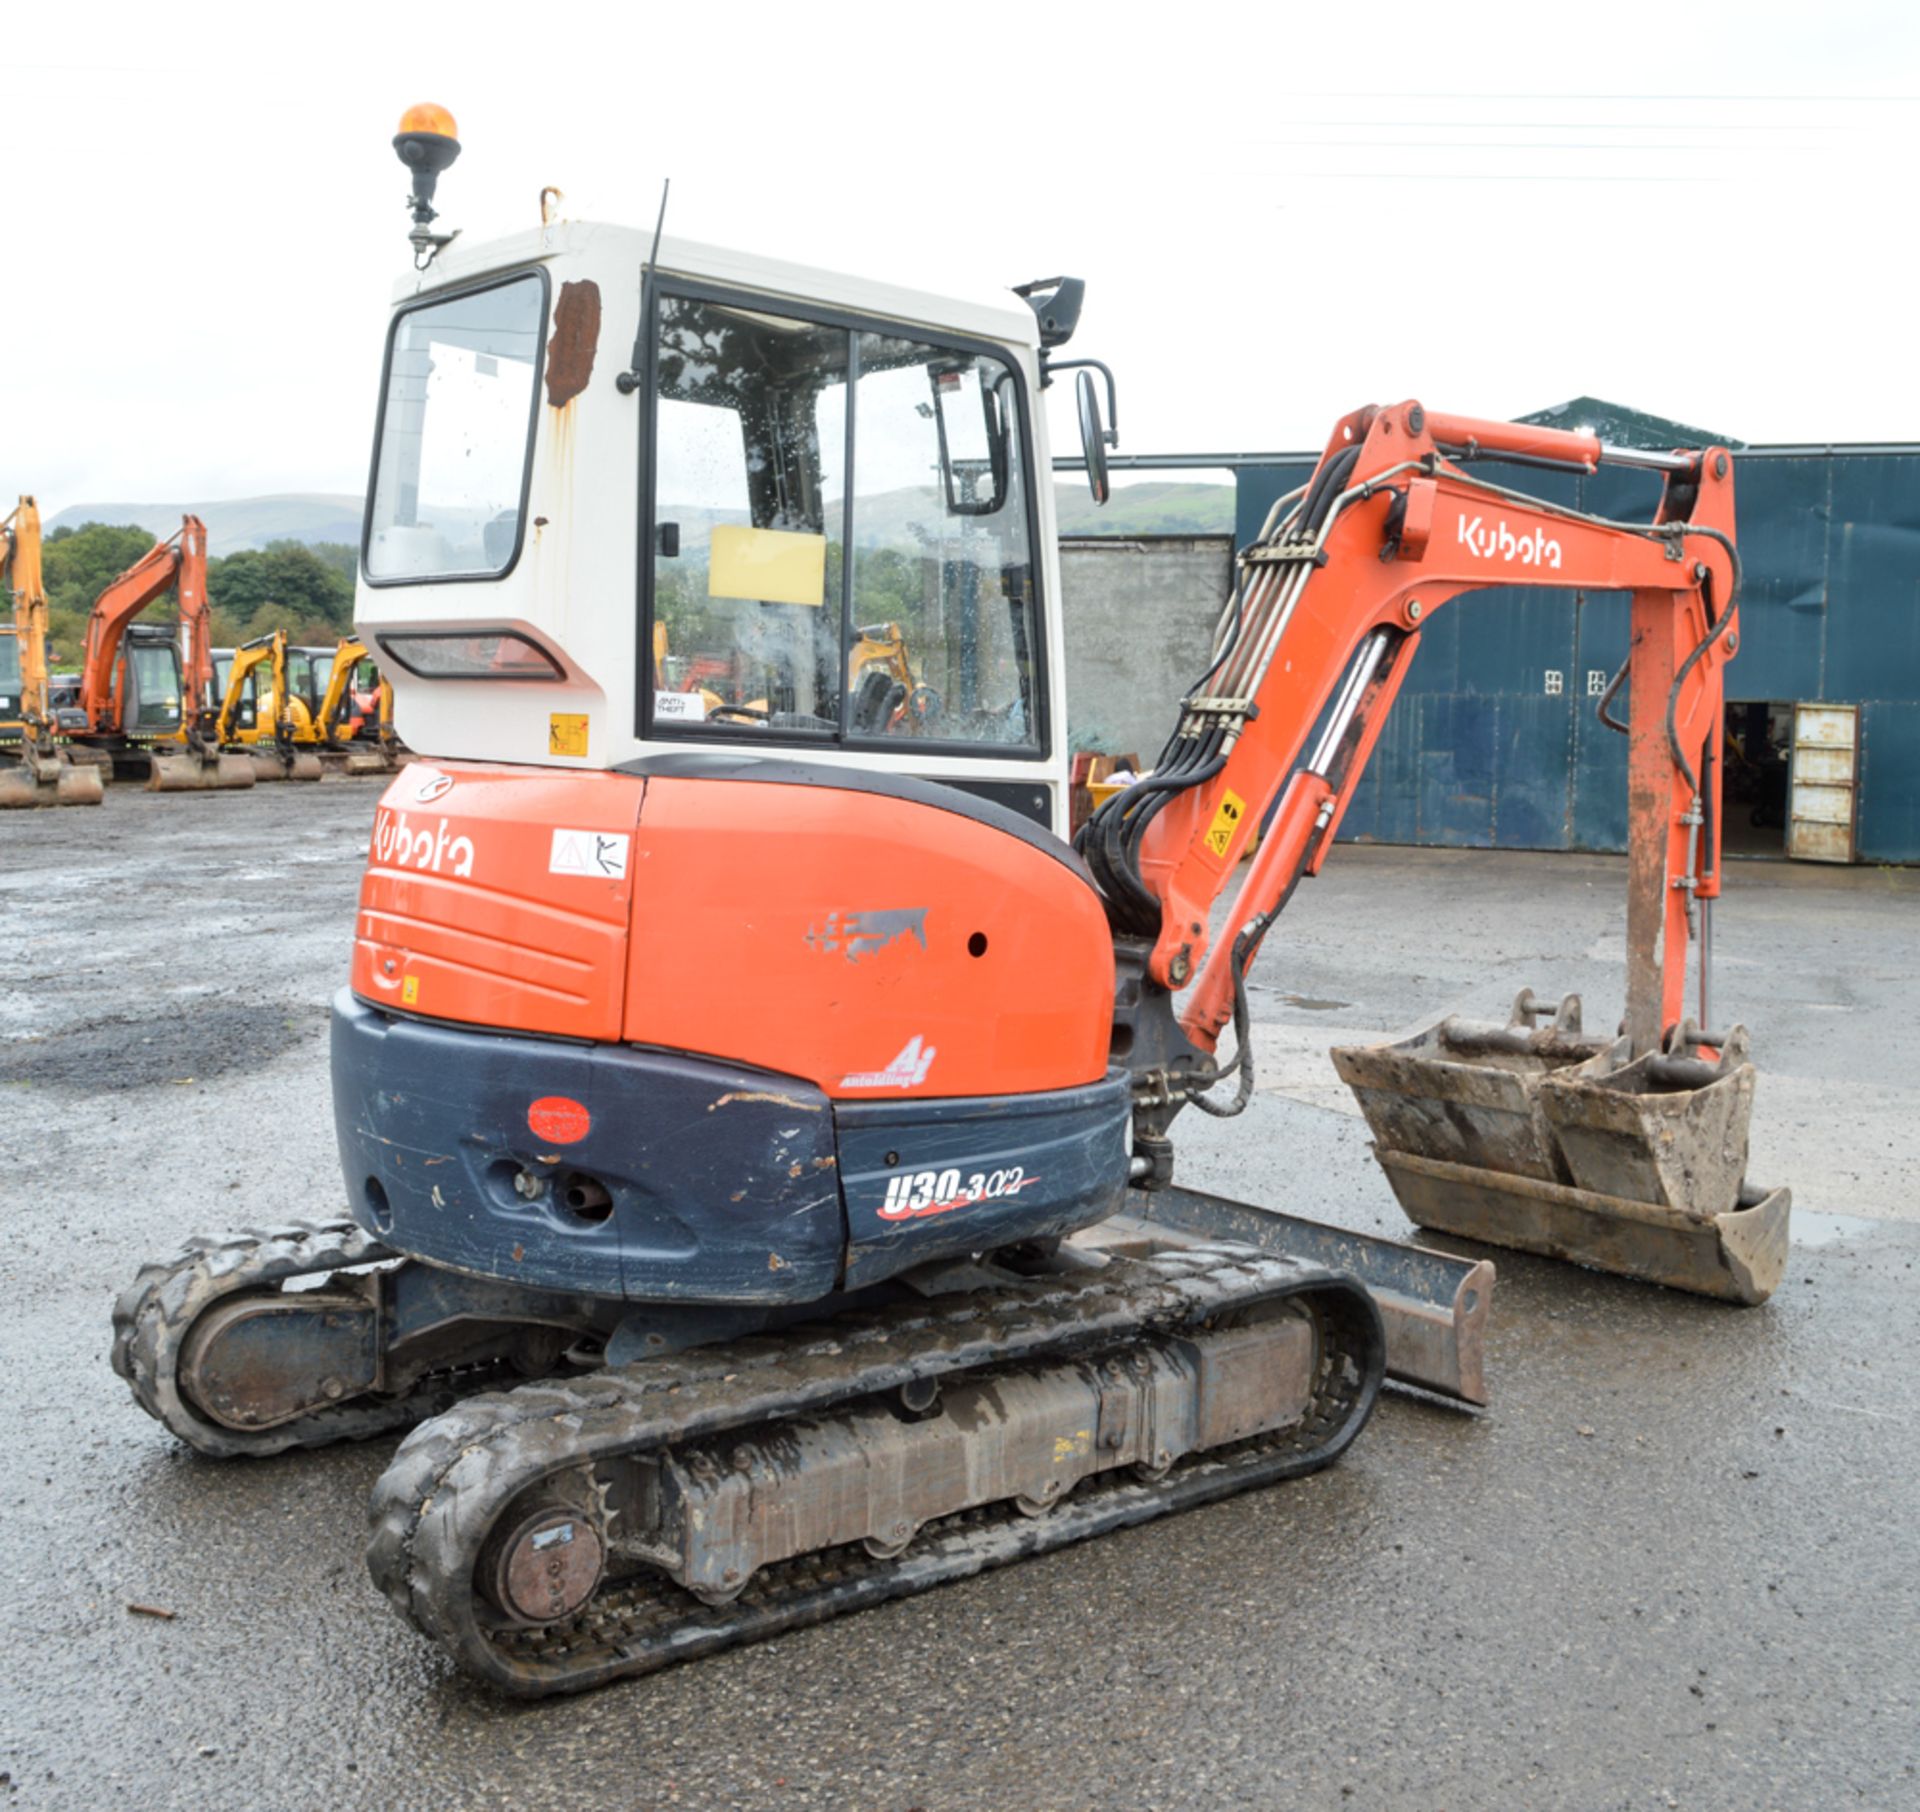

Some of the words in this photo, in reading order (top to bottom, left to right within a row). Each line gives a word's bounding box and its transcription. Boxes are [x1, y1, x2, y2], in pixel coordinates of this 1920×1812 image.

[1457, 513, 1562, 569] Kubota
[658, 705, 686, 713] THEFT
[373, 808, 476, 879] Kubota
